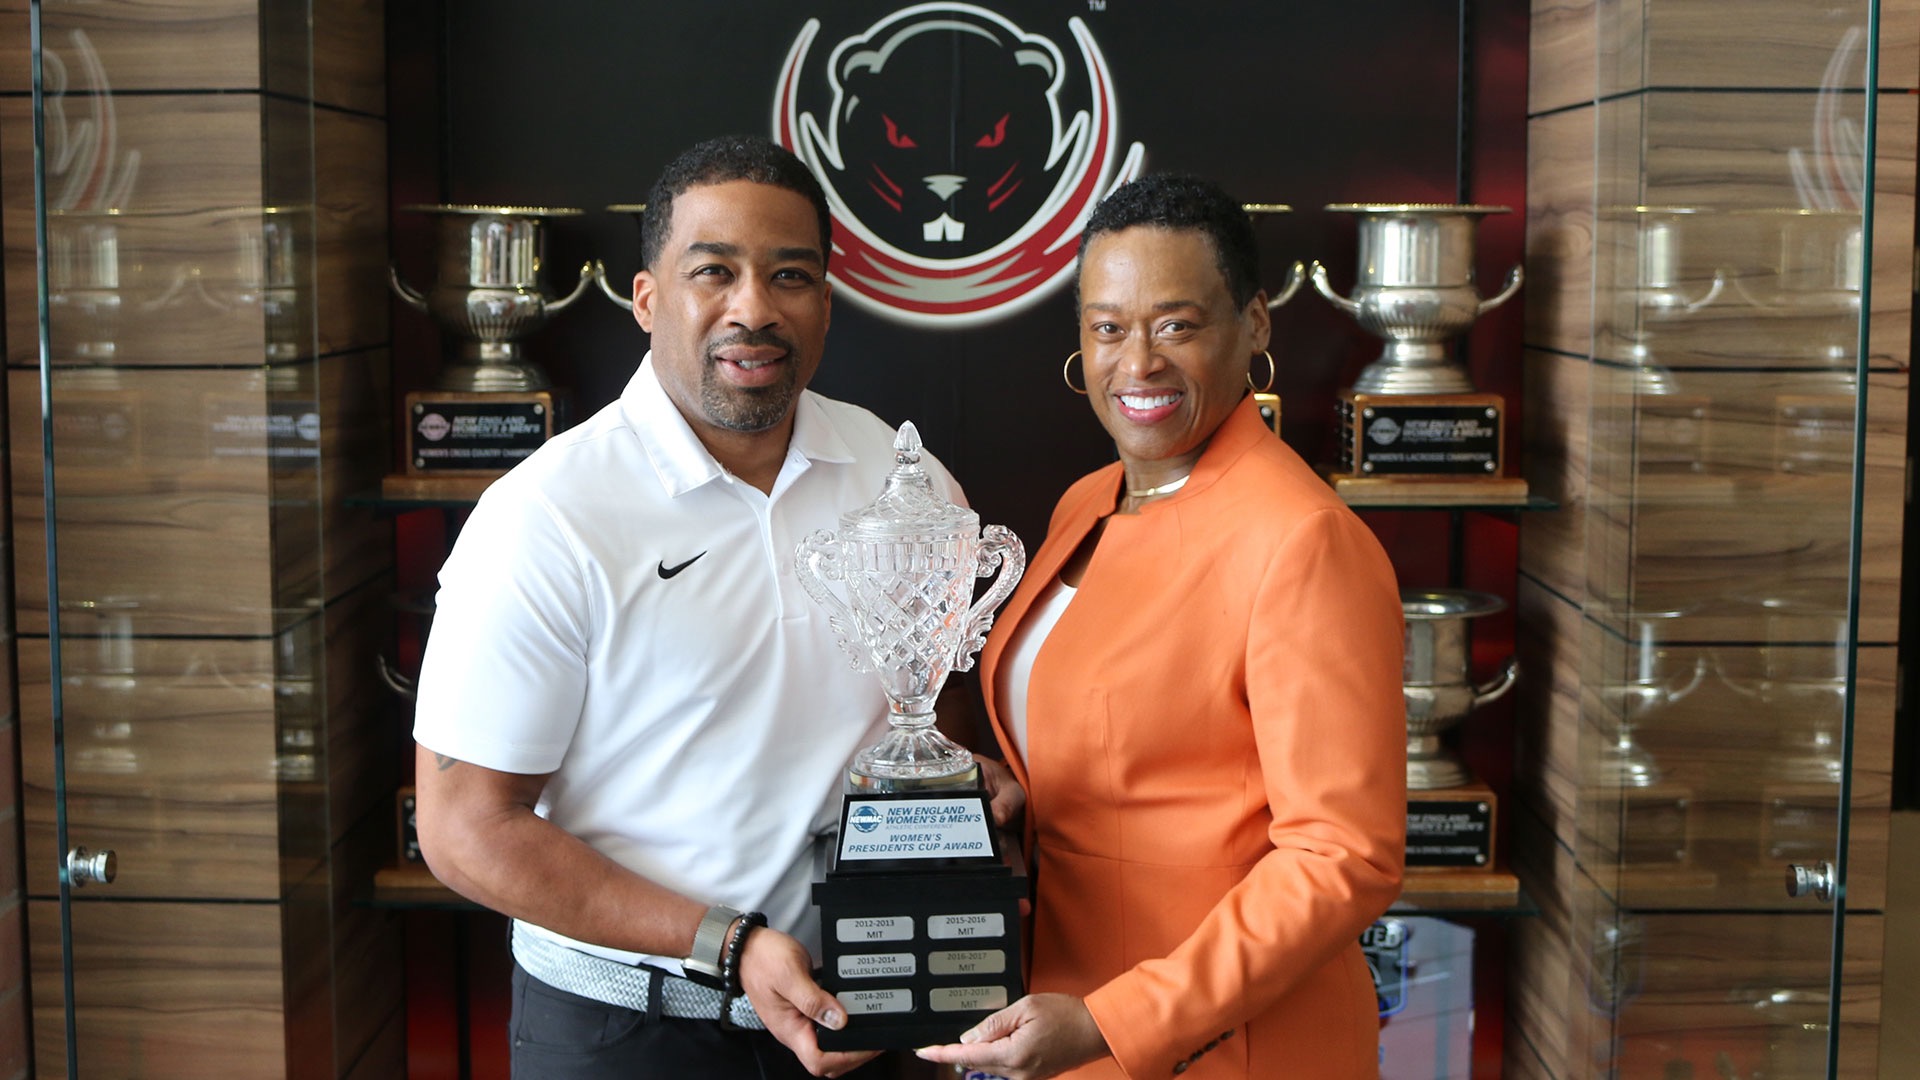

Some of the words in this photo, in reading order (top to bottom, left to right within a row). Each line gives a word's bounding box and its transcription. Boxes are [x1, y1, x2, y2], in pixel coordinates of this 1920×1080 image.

[1088, 0, 1106, 11] TM
[453, 416, 476, 425] NEW
[478, 416, 526, 425] ENGLAND
[1404, 419, 1427, 429] NEW
[1429, 419, 1478, 429] ENGLAND
[452, 424, 498, 434] WOMEN'S
[508, 424, 540, 434] MEN'S
[1402, 428, 1450, 438] WOMEN'S
[1460, 428, 1493, 438] MEN'S
[1368, 453, 1404, 462] WOMEN'S
[1406, 453, 1445, 462] LACROSSE
[1447, 452, 1492, 462] CHAMPIONS
[887, 807, 912, 816] NEW
[915, 806, 965, 815] ENGLAND
[849, 815, 882, 824] NEWMAC
[885, 815, 937, 824] WOMEN'S
[939, 814, 946, 823] &
[947, 814, 981, 823] MEN'S
[1422, 814, 1470, 823] ENGLAND
[1407, 822, 1442, 831] OMEN'S
[890, 834, 942, 843] WOMEN'S
[848, 843, 914, 853] PRESIDENTS
[918, 843, 941, 851] CUP
[944, 842, 983, 851] AWARD
[855, 920, 894, 928] 2012-2013
[945, 916, 986, 925] 2015-2016
[866, 930, 884, 939] MIT
[957, 927, 975, 936] MIT
[857, 956, 896, 965] 2013-2014
[947, 952, 987, 961] 2016-2017
[841, 967, 880, 976] WELLESLEY
[881, 966, 912, 974] COLLEGE
[958, 963, 976, 972] MIT
[854, 991, 894, 1000] 2014-2015
[948, 988, 990, 997] 2017-2018
[866, 1002, 883, 1011] MIT
[960, 1000, 978, 1009] MIT
